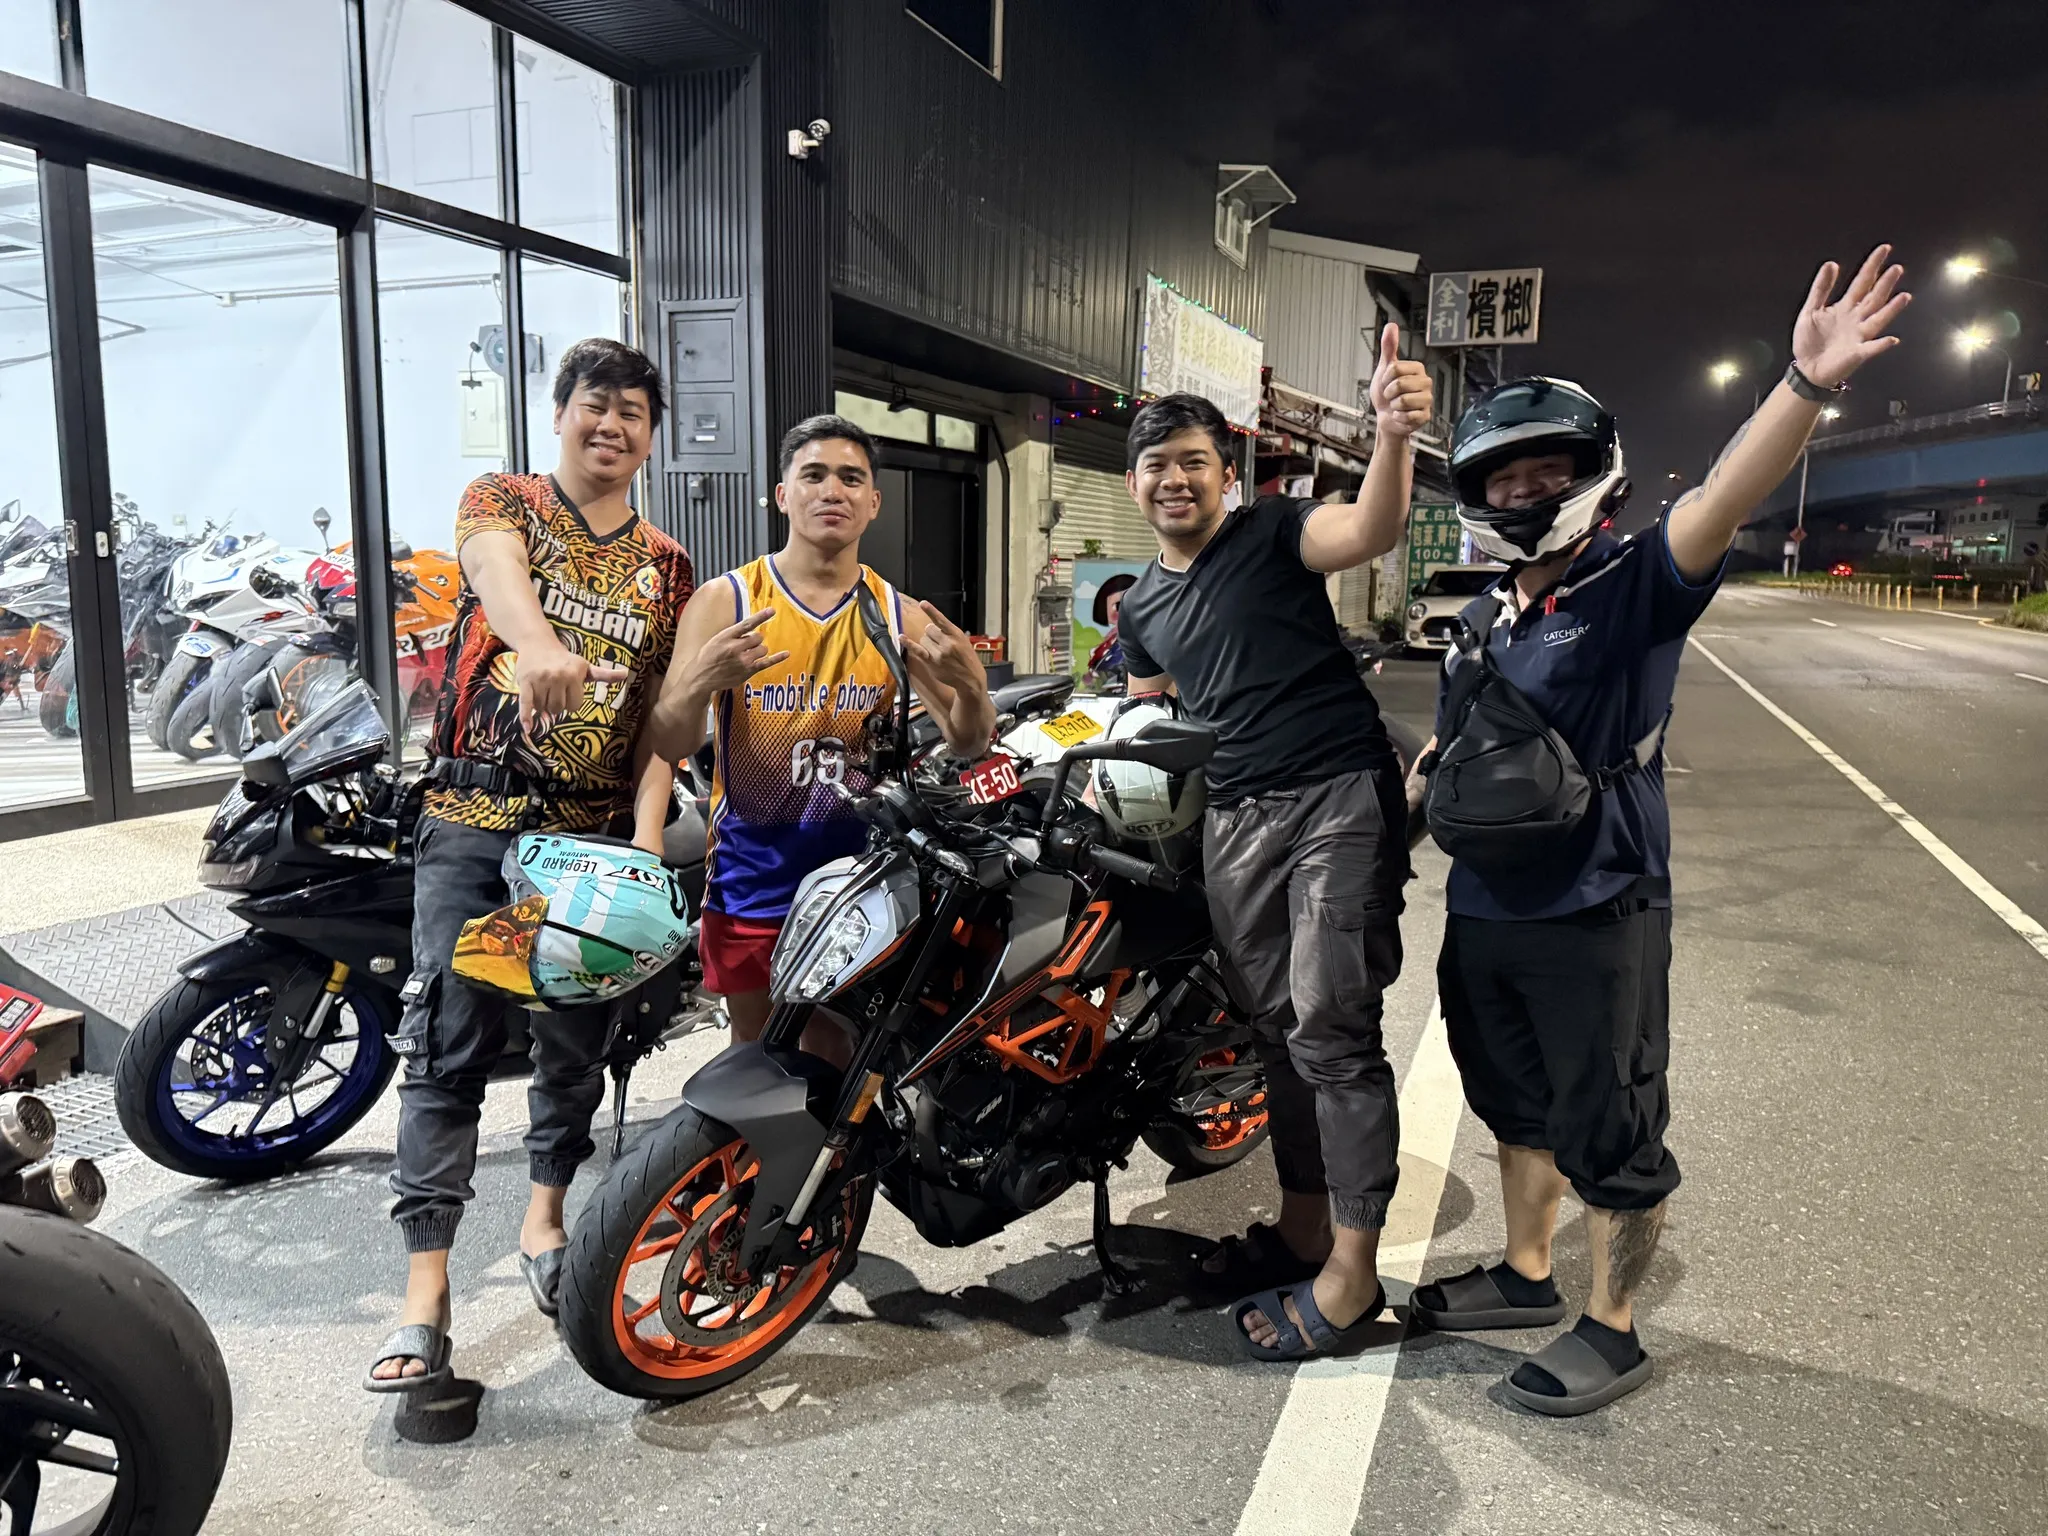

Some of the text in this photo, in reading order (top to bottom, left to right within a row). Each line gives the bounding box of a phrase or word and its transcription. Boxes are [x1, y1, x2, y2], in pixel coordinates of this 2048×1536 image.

[1433, 276, 1533, 340] 金利 檳榔
[1543, 626, 1586, 642] CATCHER
[743, 672, 829, 713] e-mobile
[541, 857, 598, 874] LEOPARD
[604, 864, 667, 894] KYT
